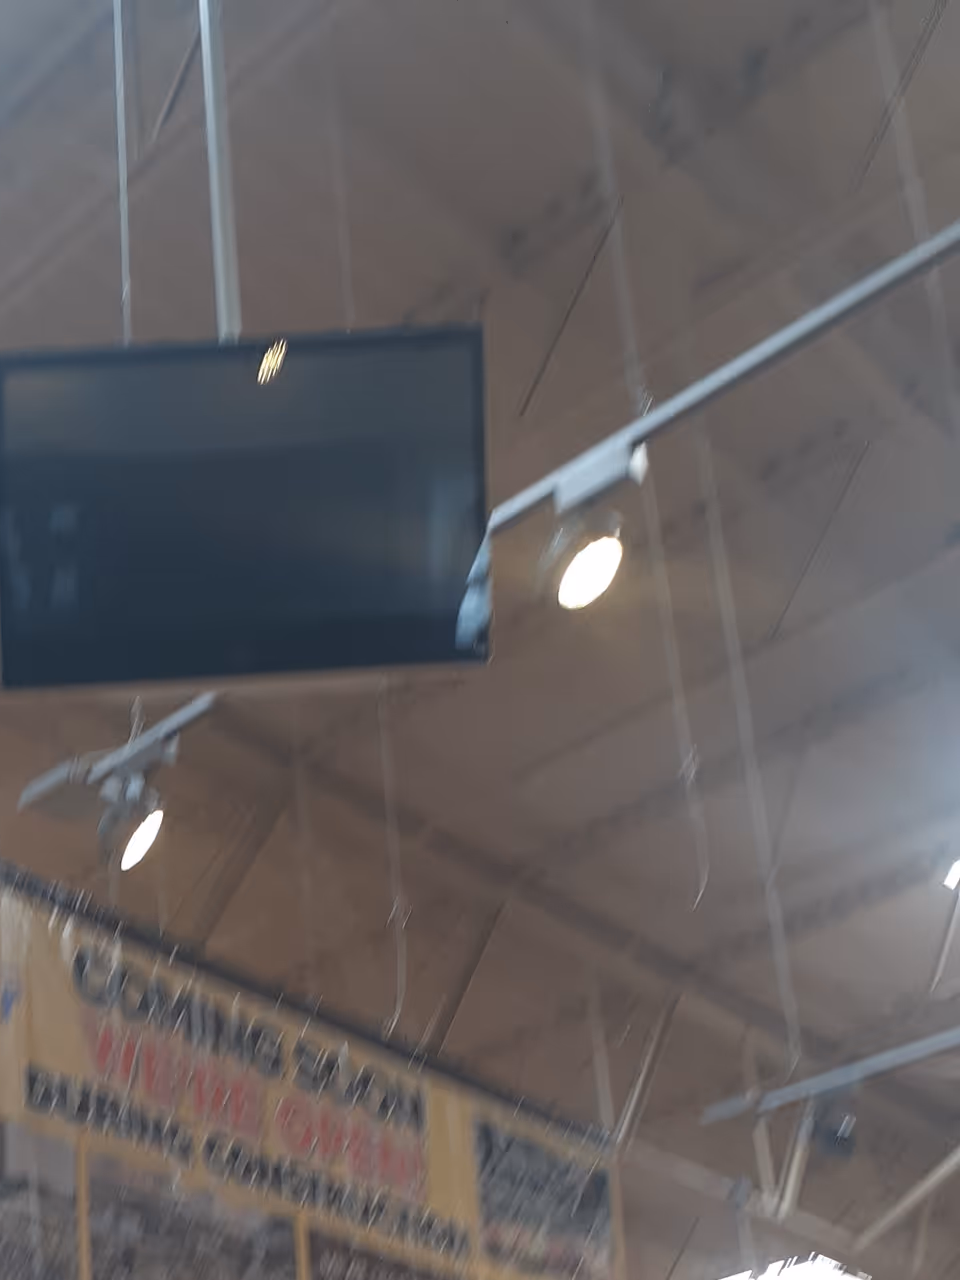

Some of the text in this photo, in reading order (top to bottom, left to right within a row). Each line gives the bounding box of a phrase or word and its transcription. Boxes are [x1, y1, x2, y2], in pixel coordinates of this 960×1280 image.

[72, 946, 426, 1130] COMING SOON
[23, 1063, 471, 1258] DURING CONSTRUCTION
